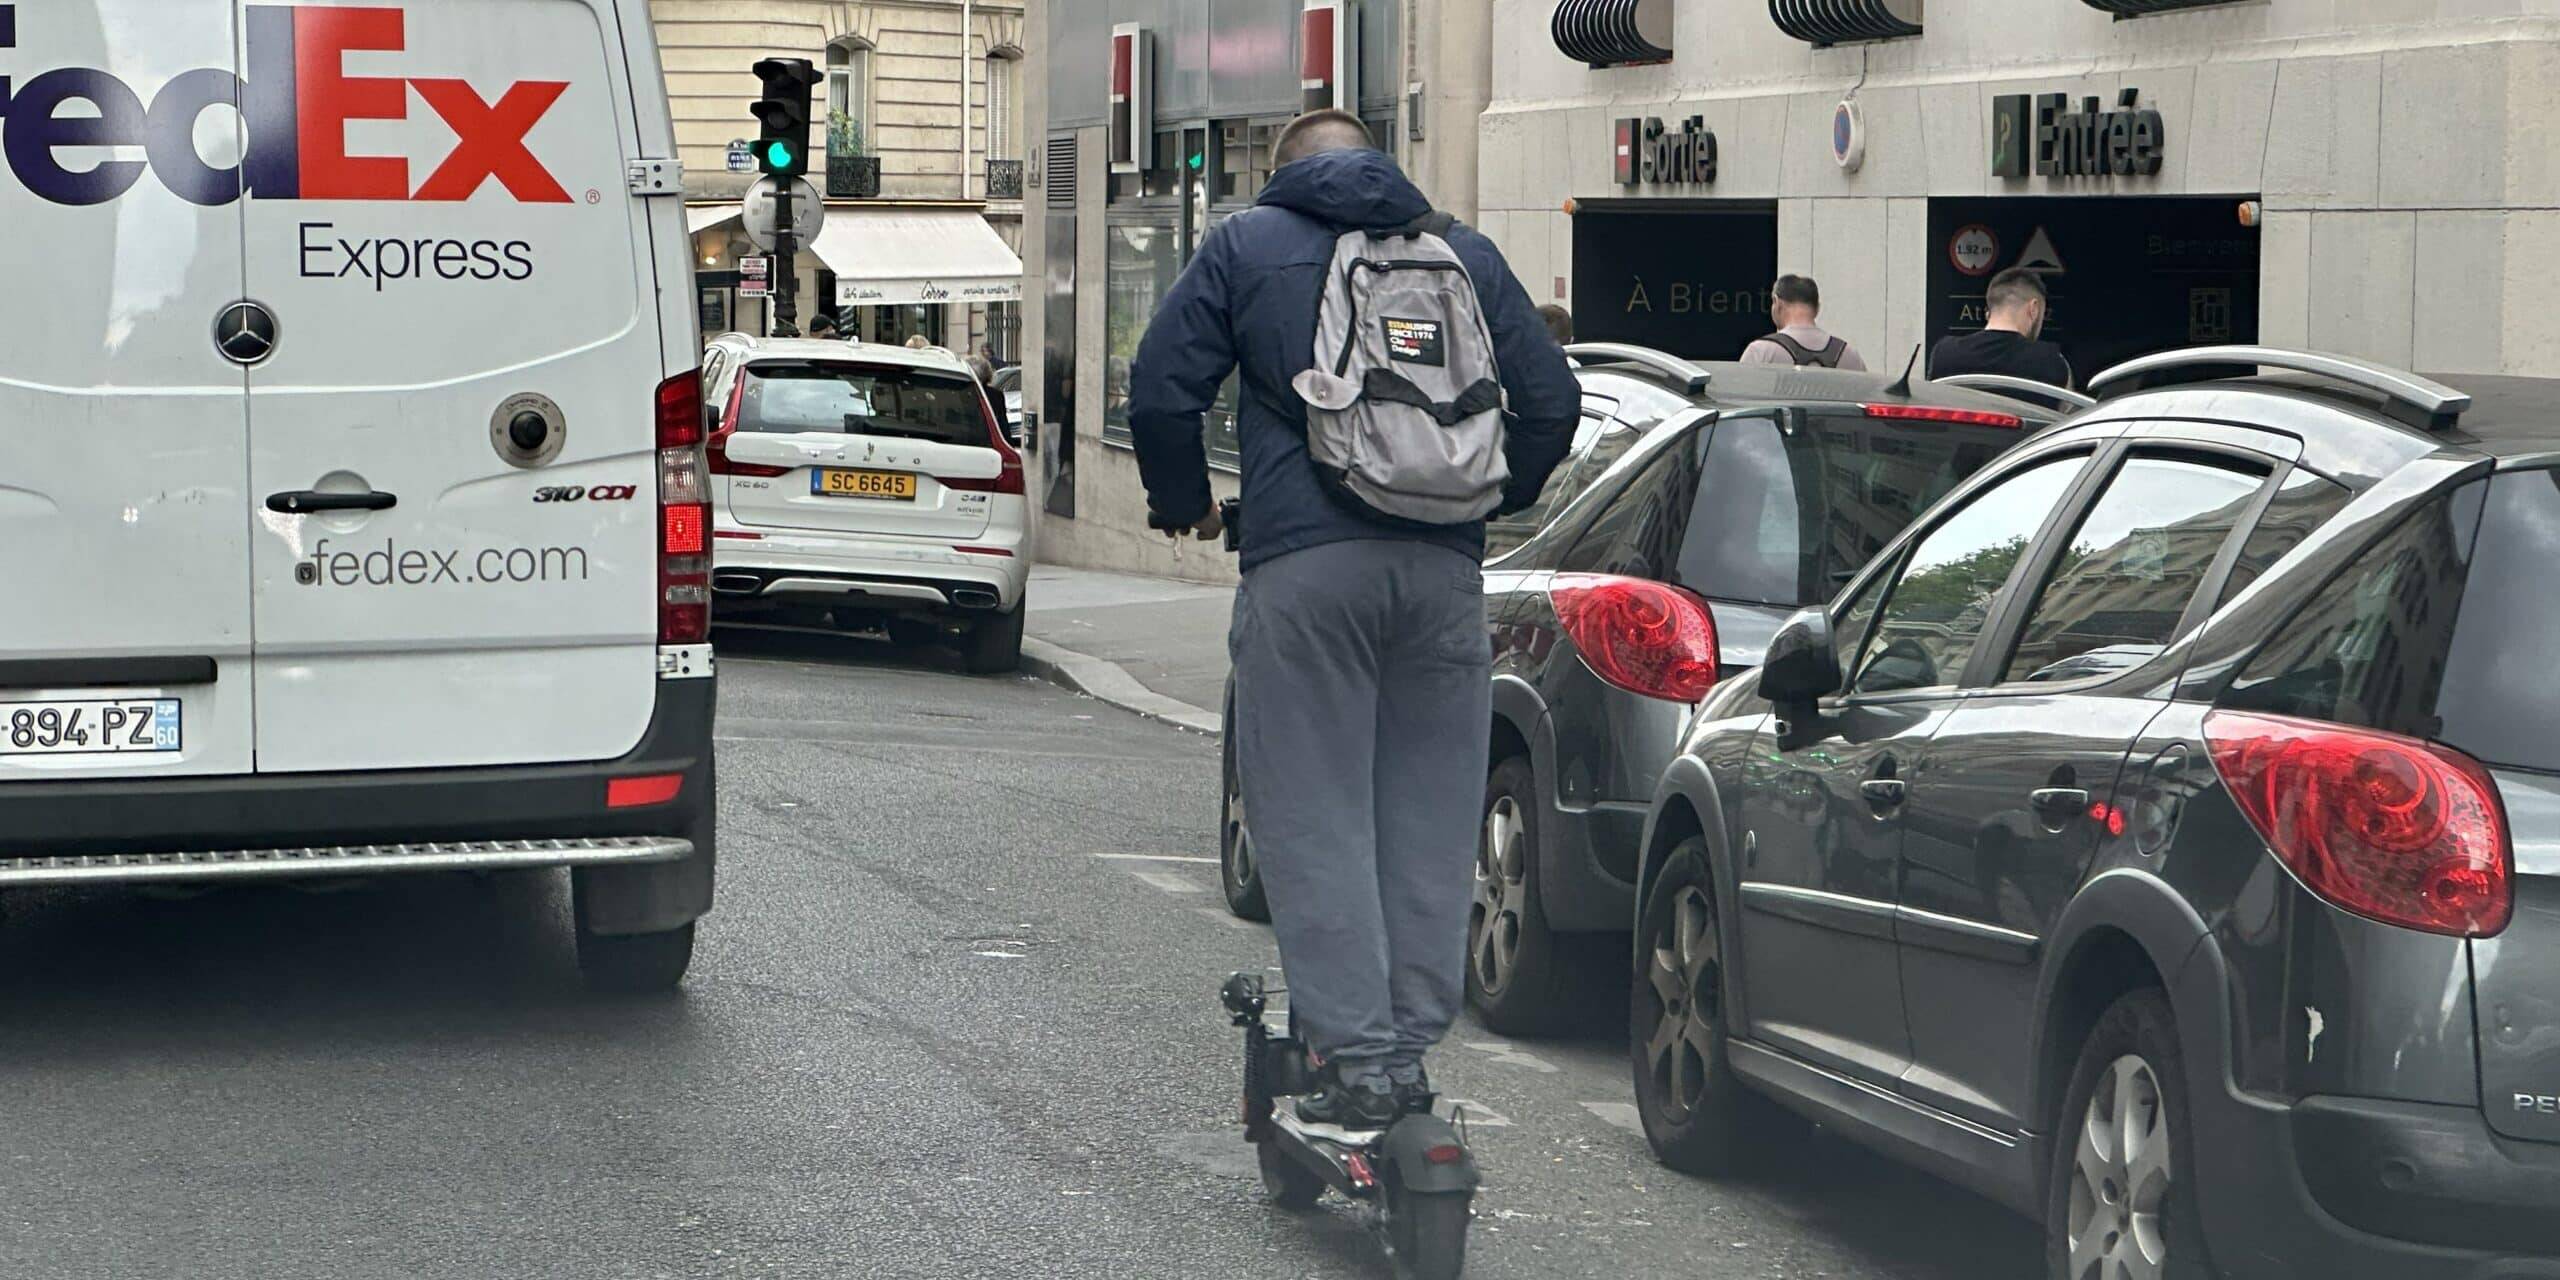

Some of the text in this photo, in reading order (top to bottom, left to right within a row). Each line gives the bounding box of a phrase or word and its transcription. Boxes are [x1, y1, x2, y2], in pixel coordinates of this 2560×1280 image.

[0, 4, 576, 207] edEx
[1641, 114, 1718, 184] Sortie
[2036, 88, 2164, 175] Entrée
[299, 222, 534, 292] Express
[1626, 275, 1771, 313] À Bient
[533, 485, 637, 503] 310 CDI
[831, 473, 906, 494] SC 6645
[310, 537, 588, 586] fedex.com
[156, 726, 177, 746] 60
[2513, 1093, 2560, 1113] PE
